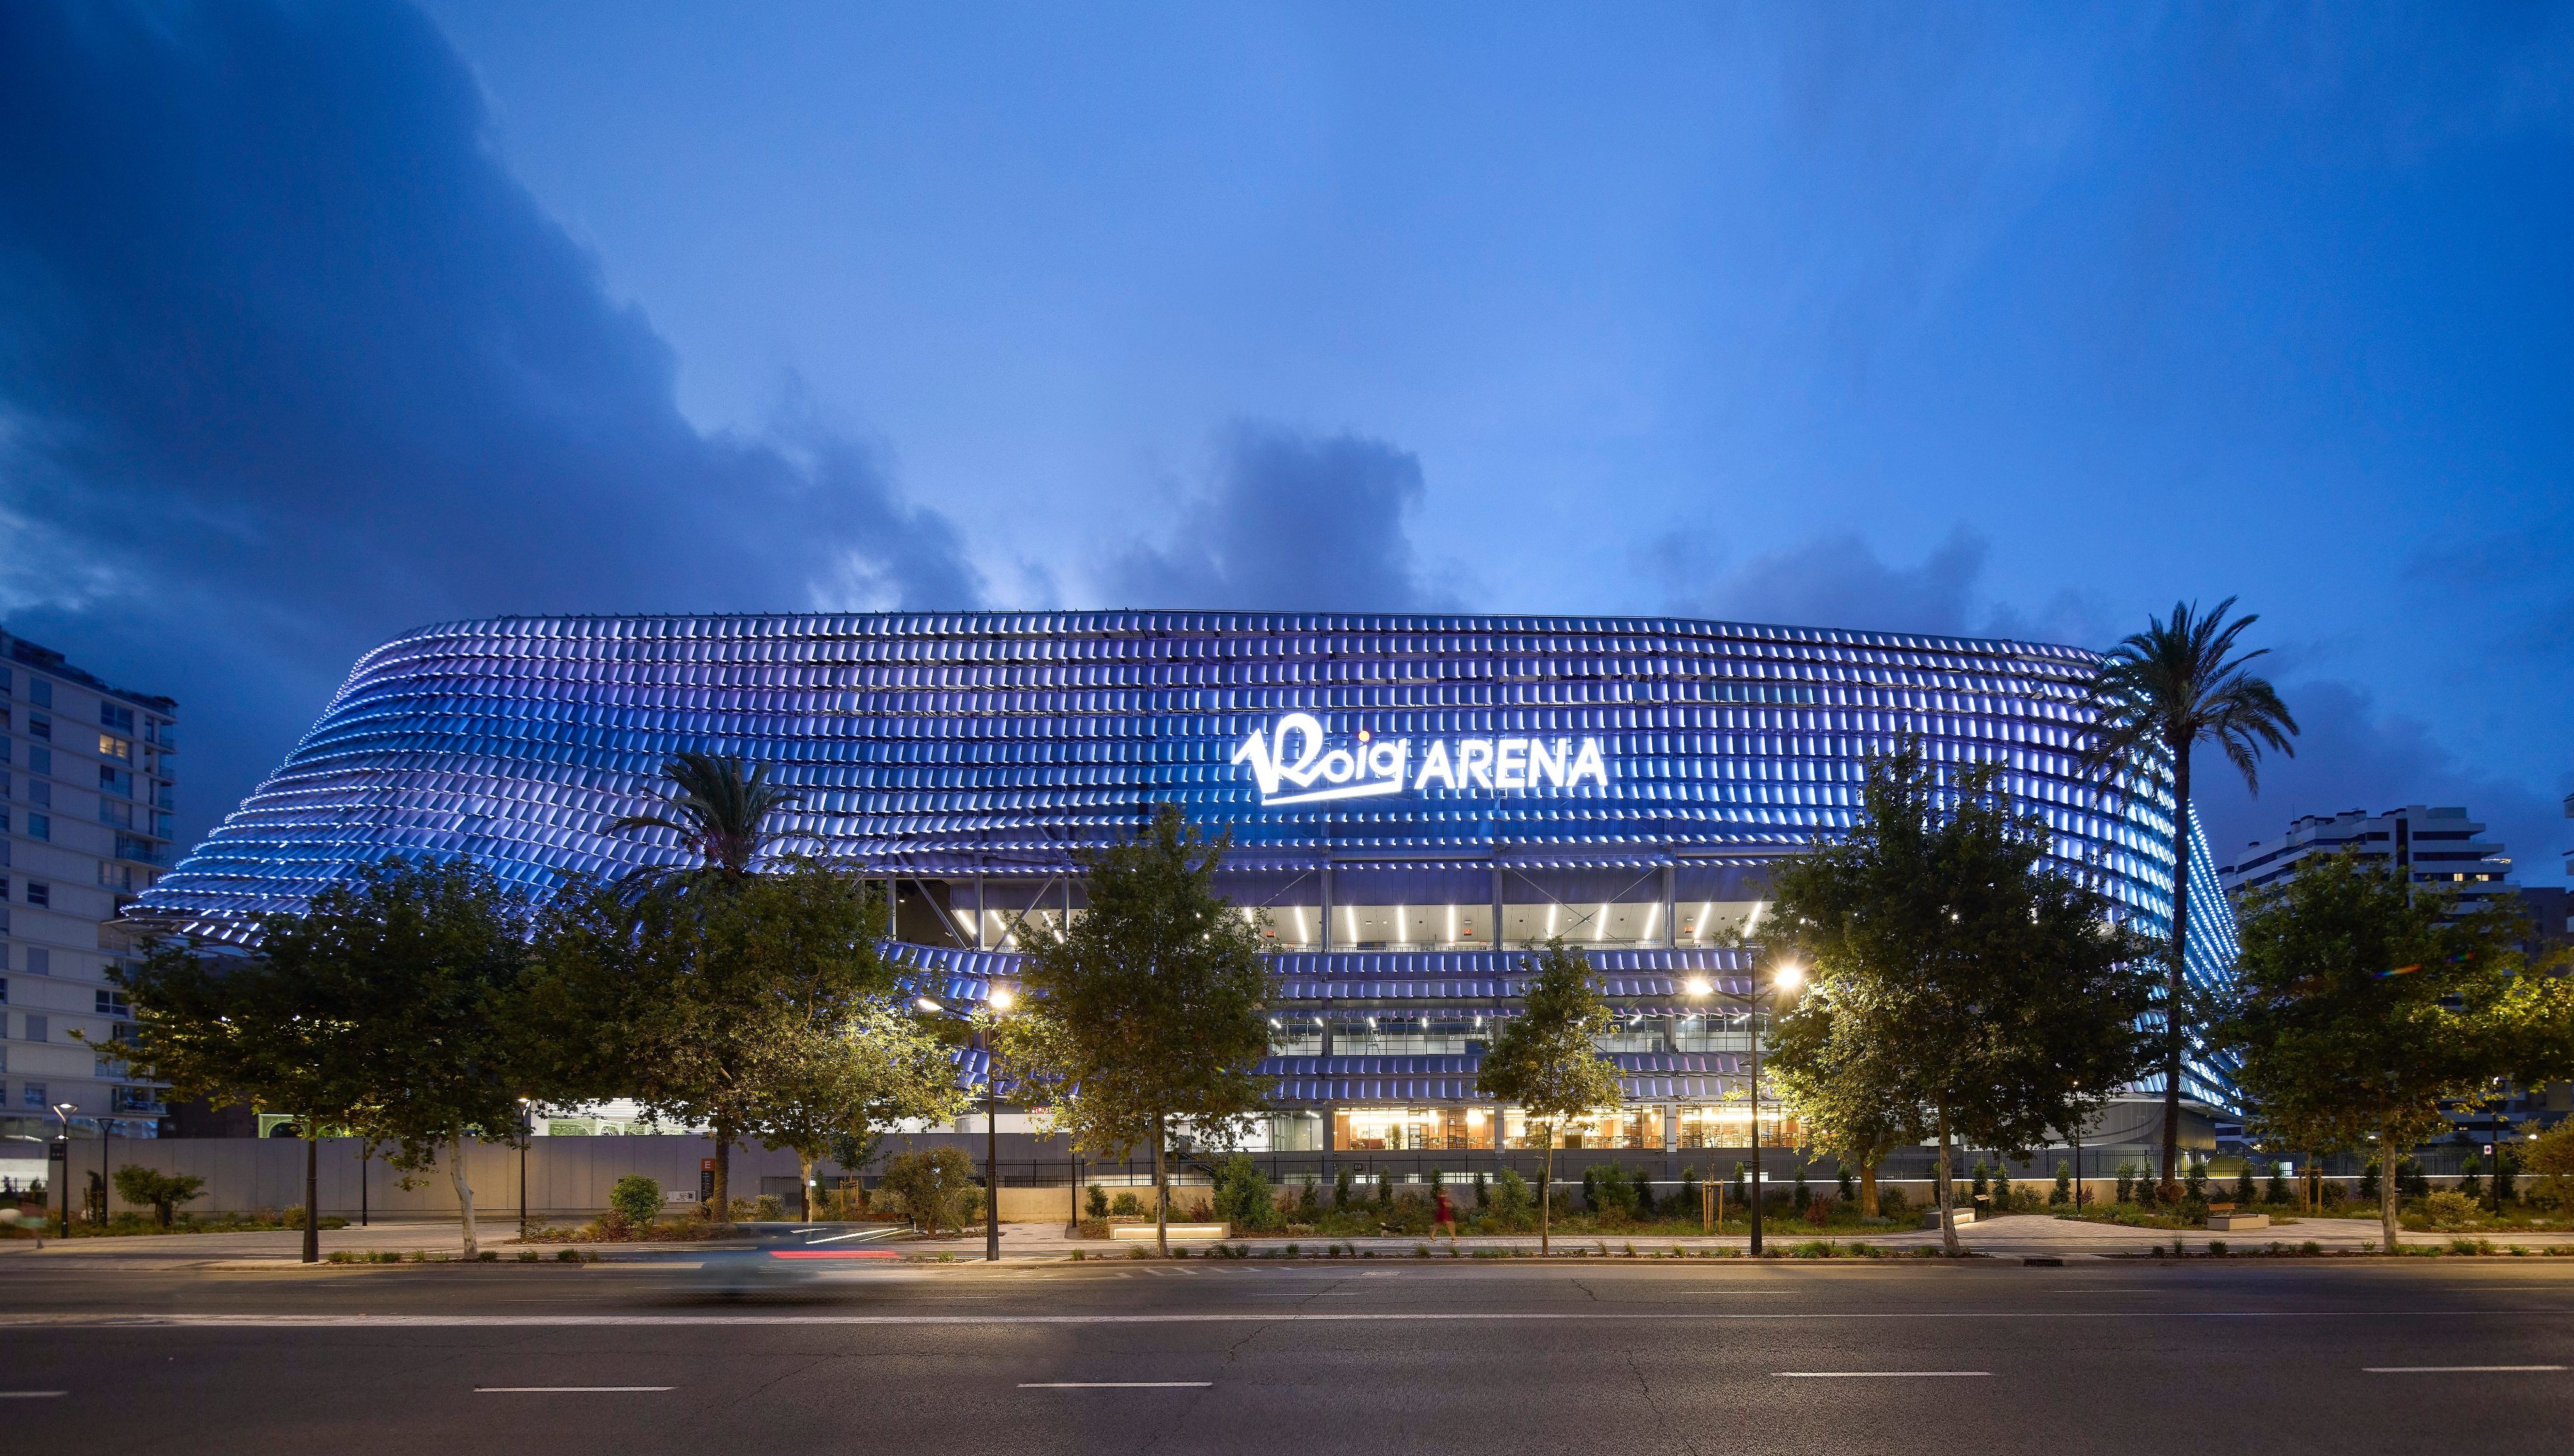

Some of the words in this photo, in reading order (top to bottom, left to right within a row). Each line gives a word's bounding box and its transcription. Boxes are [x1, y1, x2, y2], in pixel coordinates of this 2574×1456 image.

[1230, 713, 1407, 806] Roig
[1414, 737, 1608, 789] ARENA
[705, 1161, 711, 1169] E
